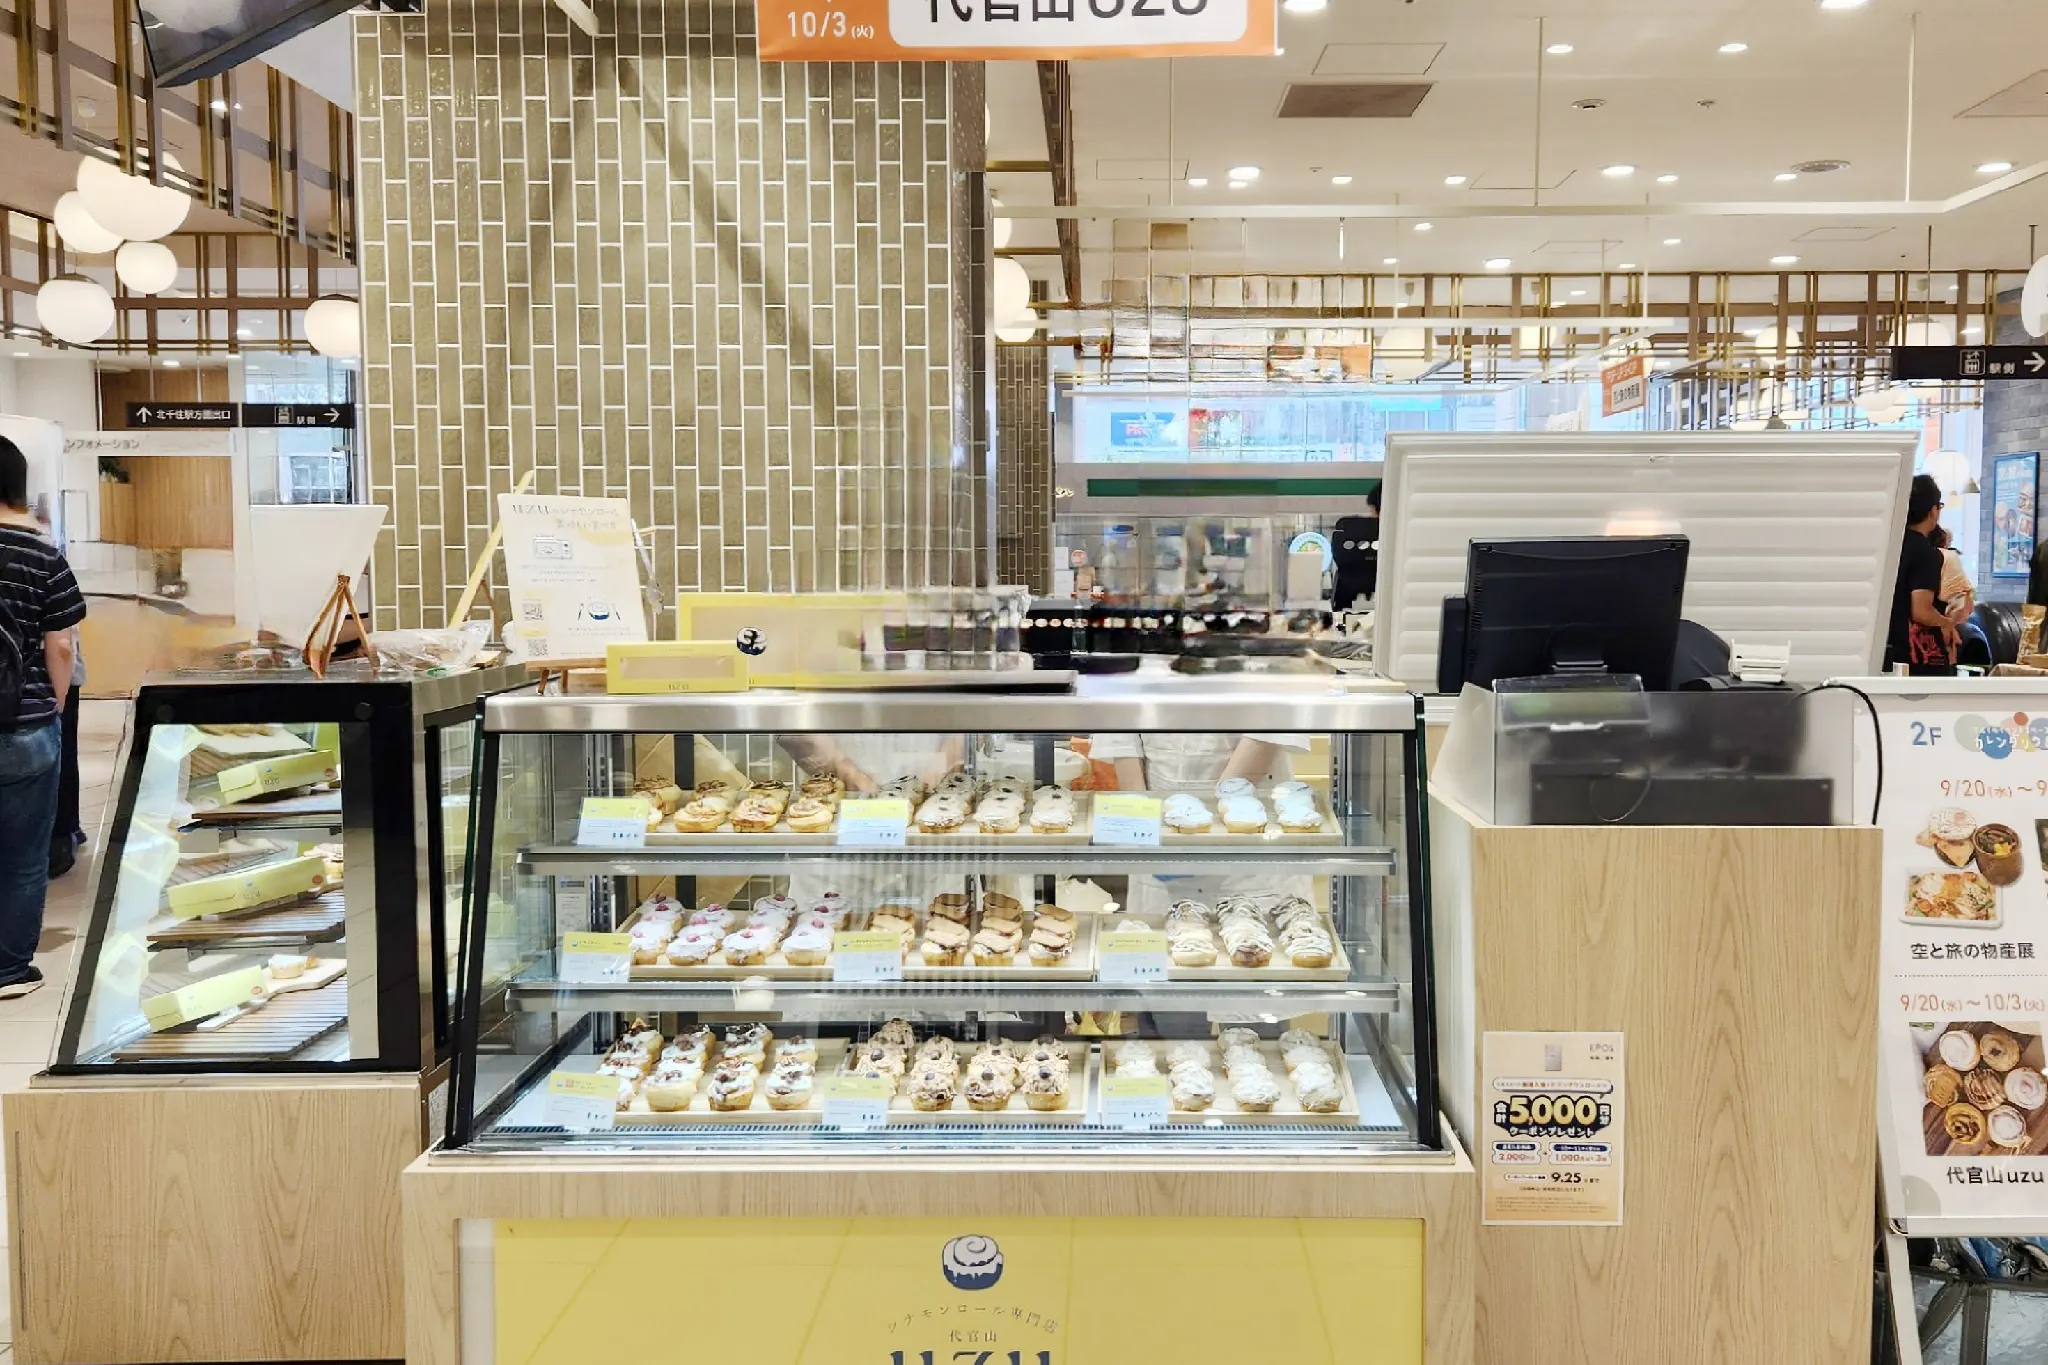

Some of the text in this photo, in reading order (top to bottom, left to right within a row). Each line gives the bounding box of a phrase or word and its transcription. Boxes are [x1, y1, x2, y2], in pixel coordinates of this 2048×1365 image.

[788, 11, 875, 39] 10/3(火)
[1910, 721, 1942, 746] 2F
[1910, 942, 2036, 960] 空と旅の物産展
[1509, 1097, 1597, 1126] 5,000
[949, 1329, 997, 1343] 代官山
